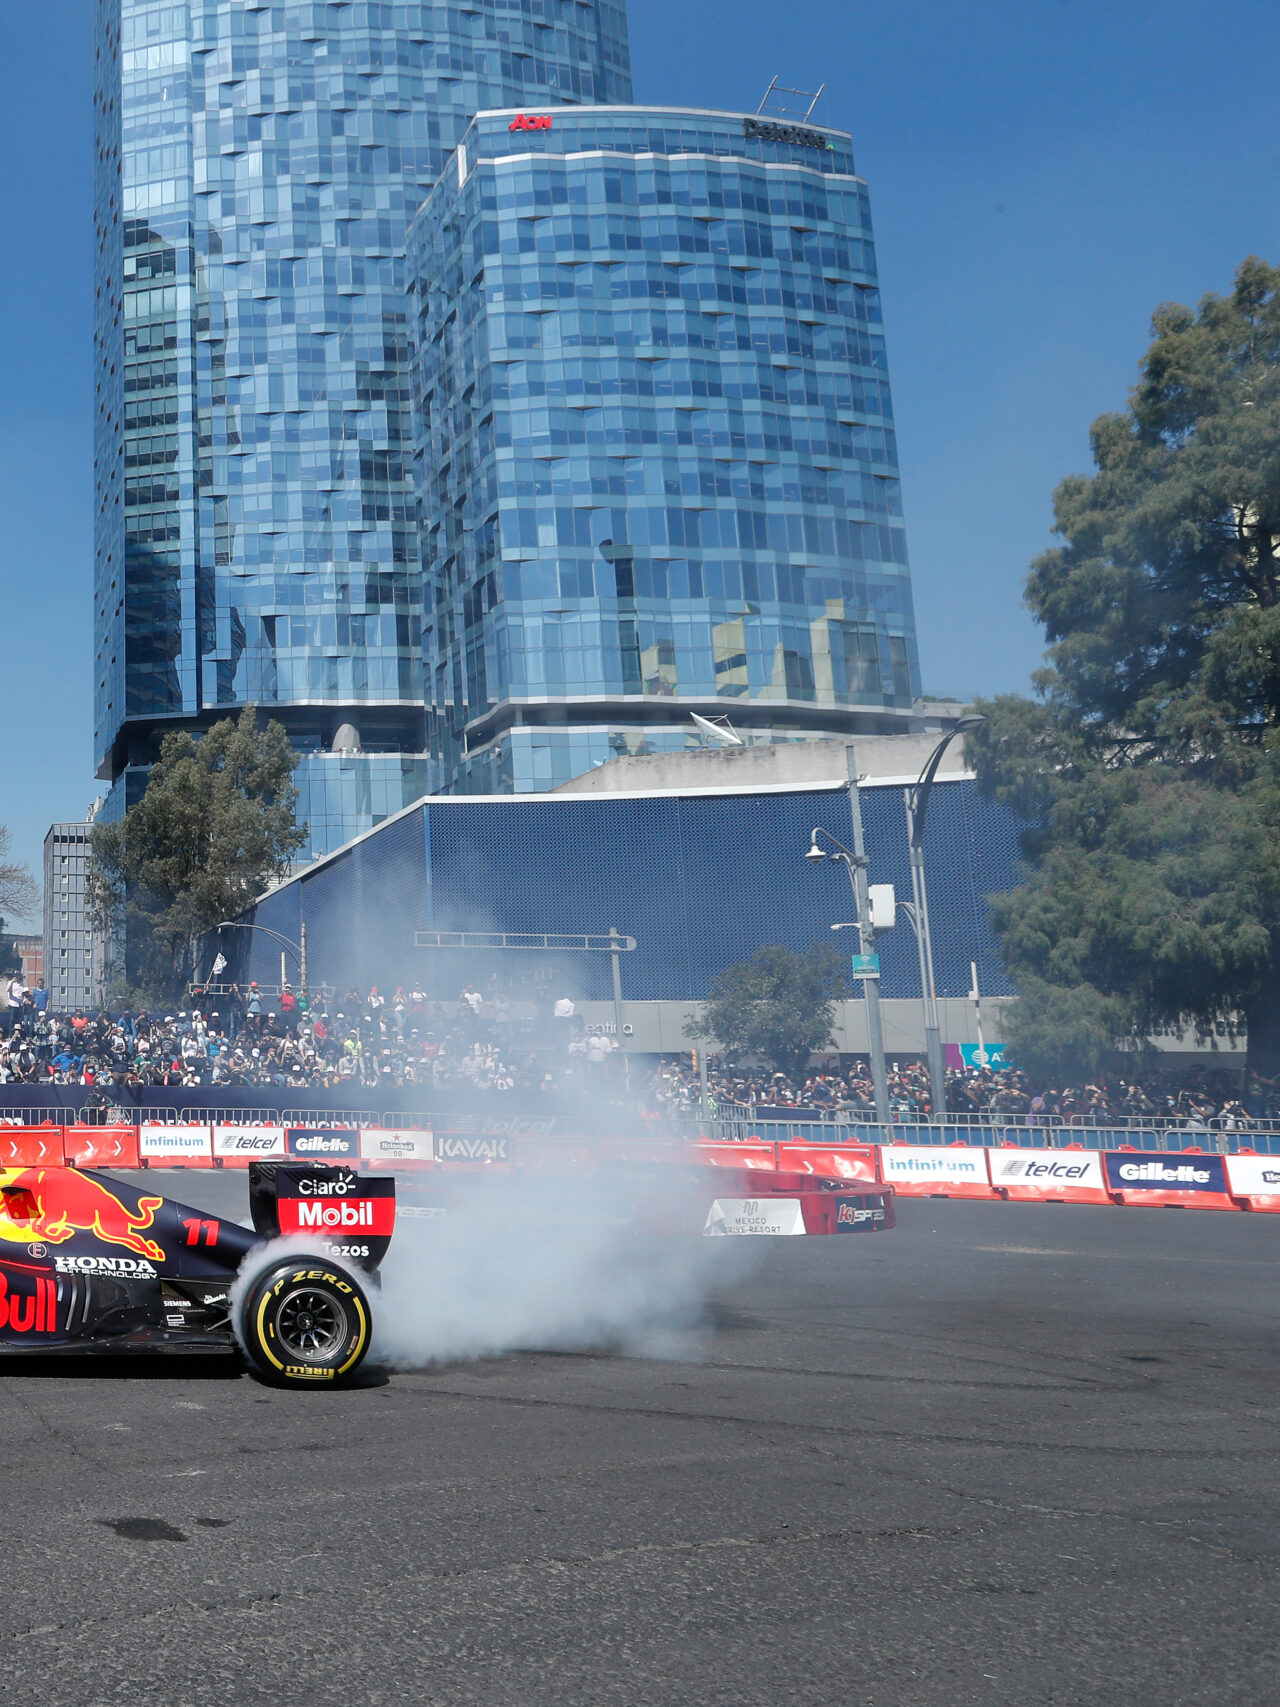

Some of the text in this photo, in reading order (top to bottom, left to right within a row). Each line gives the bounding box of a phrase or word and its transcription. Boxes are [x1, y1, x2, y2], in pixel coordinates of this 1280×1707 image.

[145, 1136, 204, 1147] infinitum
[236, 1135, 278, 1149] telcel
[295, 1136, 350, 1152] Gillette
[439, 1138, 507, 1158] KAVAK
[889, 1157, 976, 1173] infinitum
[1024, 1160, 1091, 1179] telcel
[1119, 1162, 1211, 1184] Gillette
[298, 1201, 373, 1227] Mobil
[182, 1218, 220, 1247] 11
[322, 1242, 369, 1257] Tezos
[54, 1256, 157, 1273] HONDA
[292, 1270, 352, 1294] ZERO
[284, 1365, 335, 1380] PIRELLI
